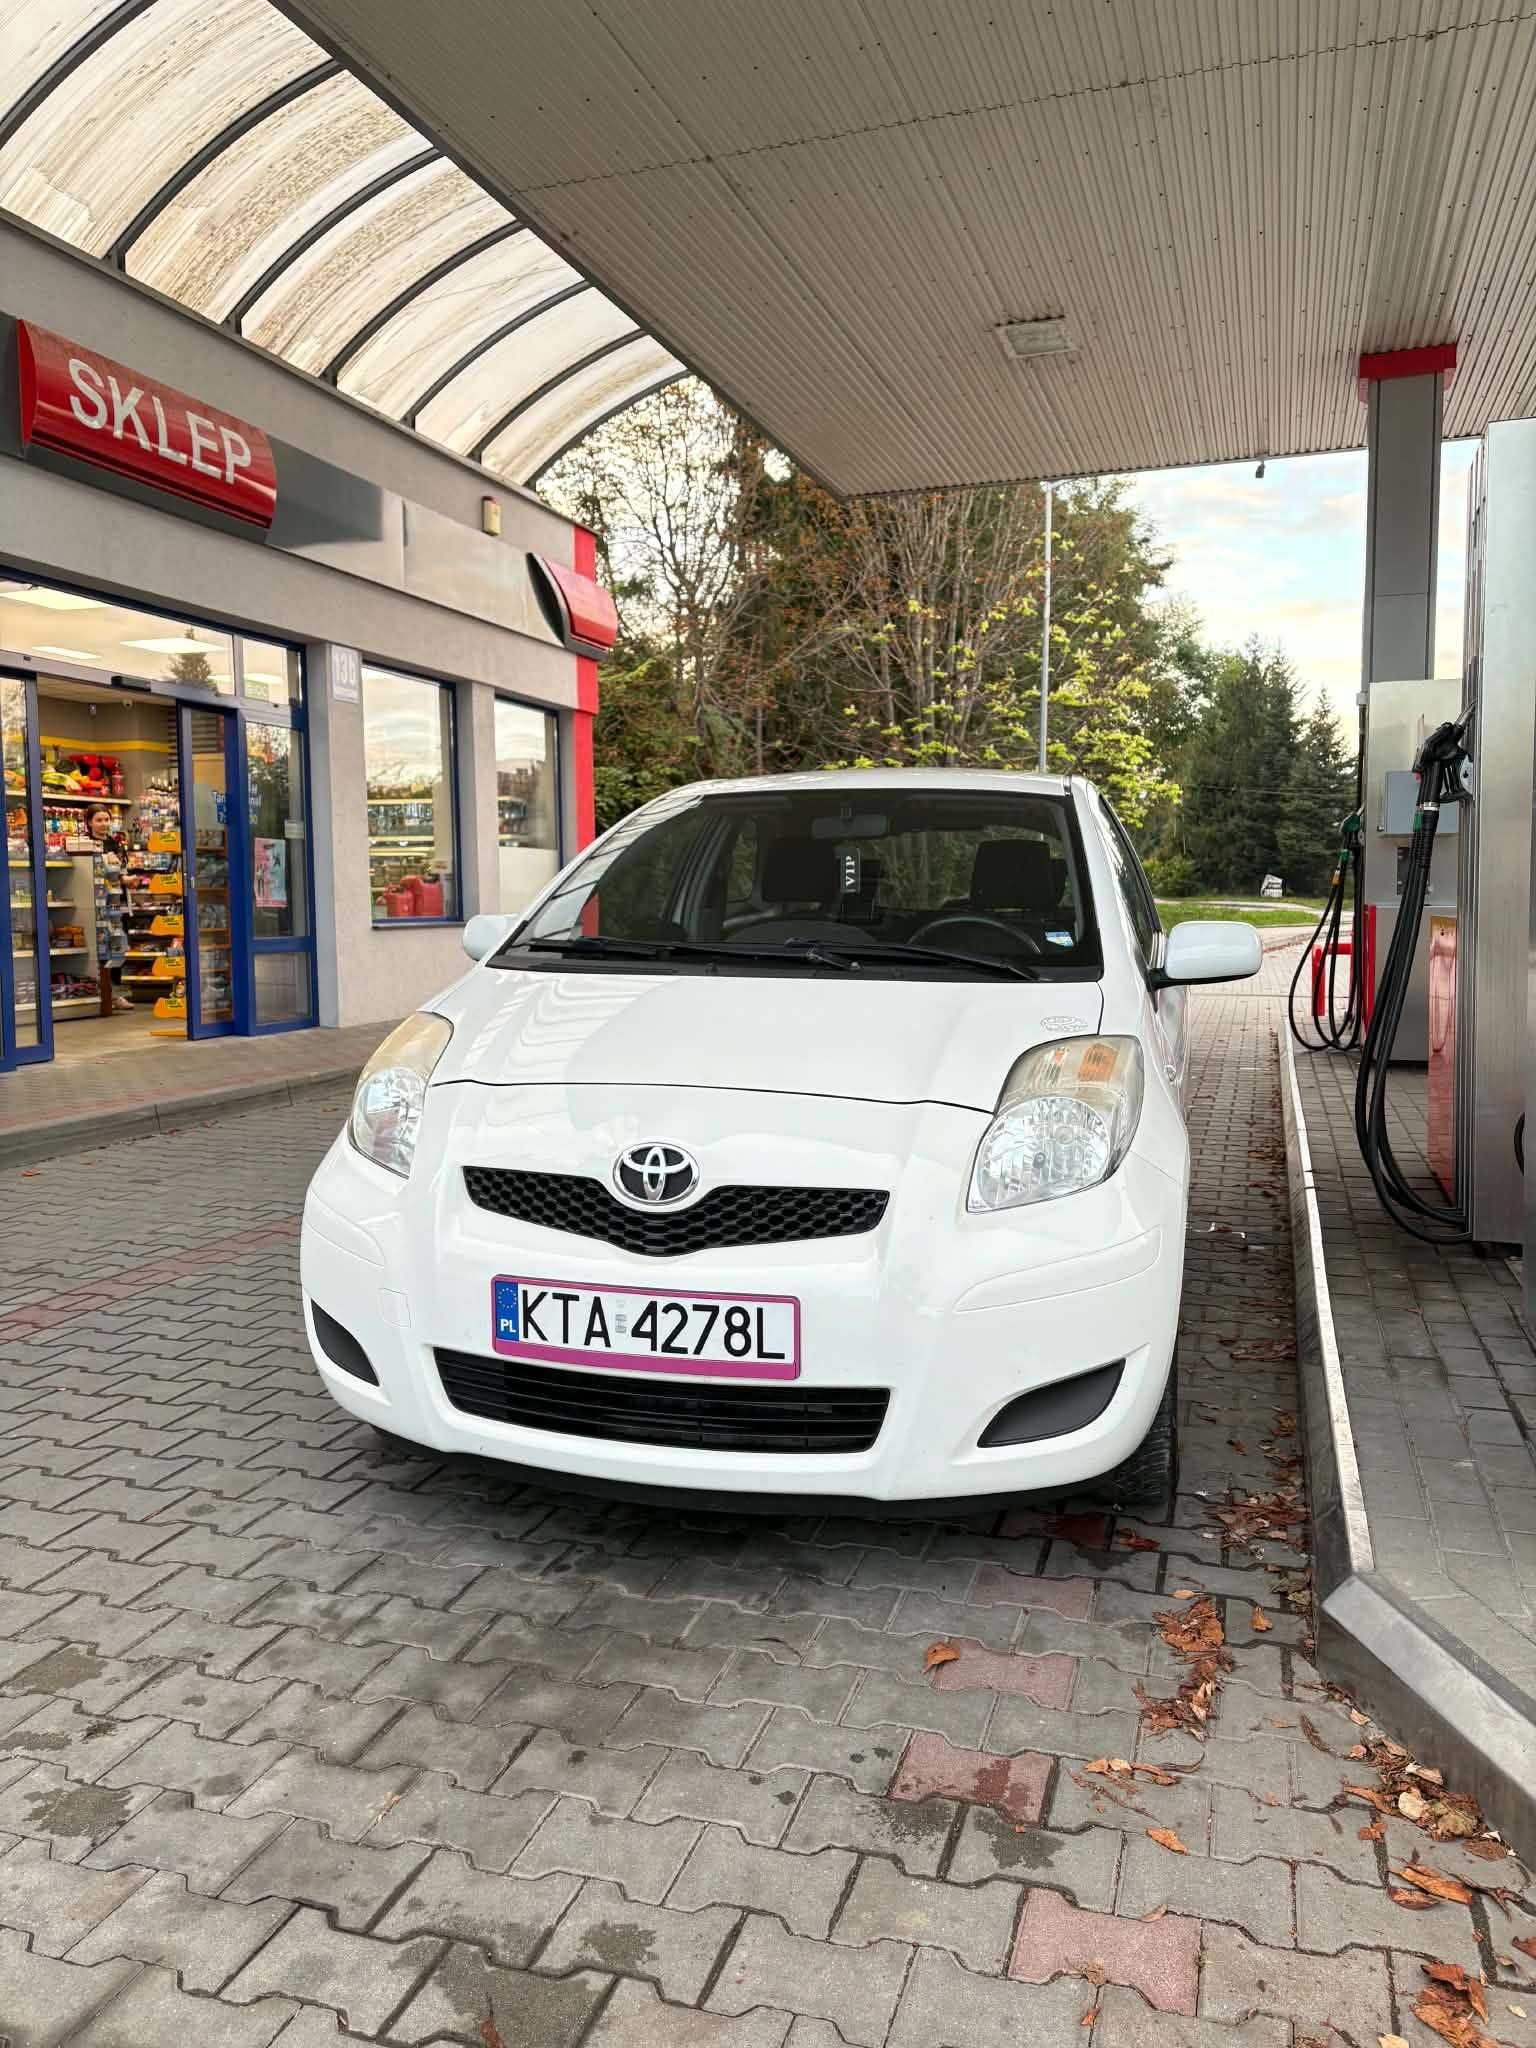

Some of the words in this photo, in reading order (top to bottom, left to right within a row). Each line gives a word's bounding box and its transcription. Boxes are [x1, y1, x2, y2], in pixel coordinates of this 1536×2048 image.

[69, 358, 251, 484] SKLEP
[845, 855, 856, 888] VIP
[500, 1318, 517, 1333] PL
[522, 1289, 611, 1348] KTA
[631, 1300, 786, 1360] 4278L
